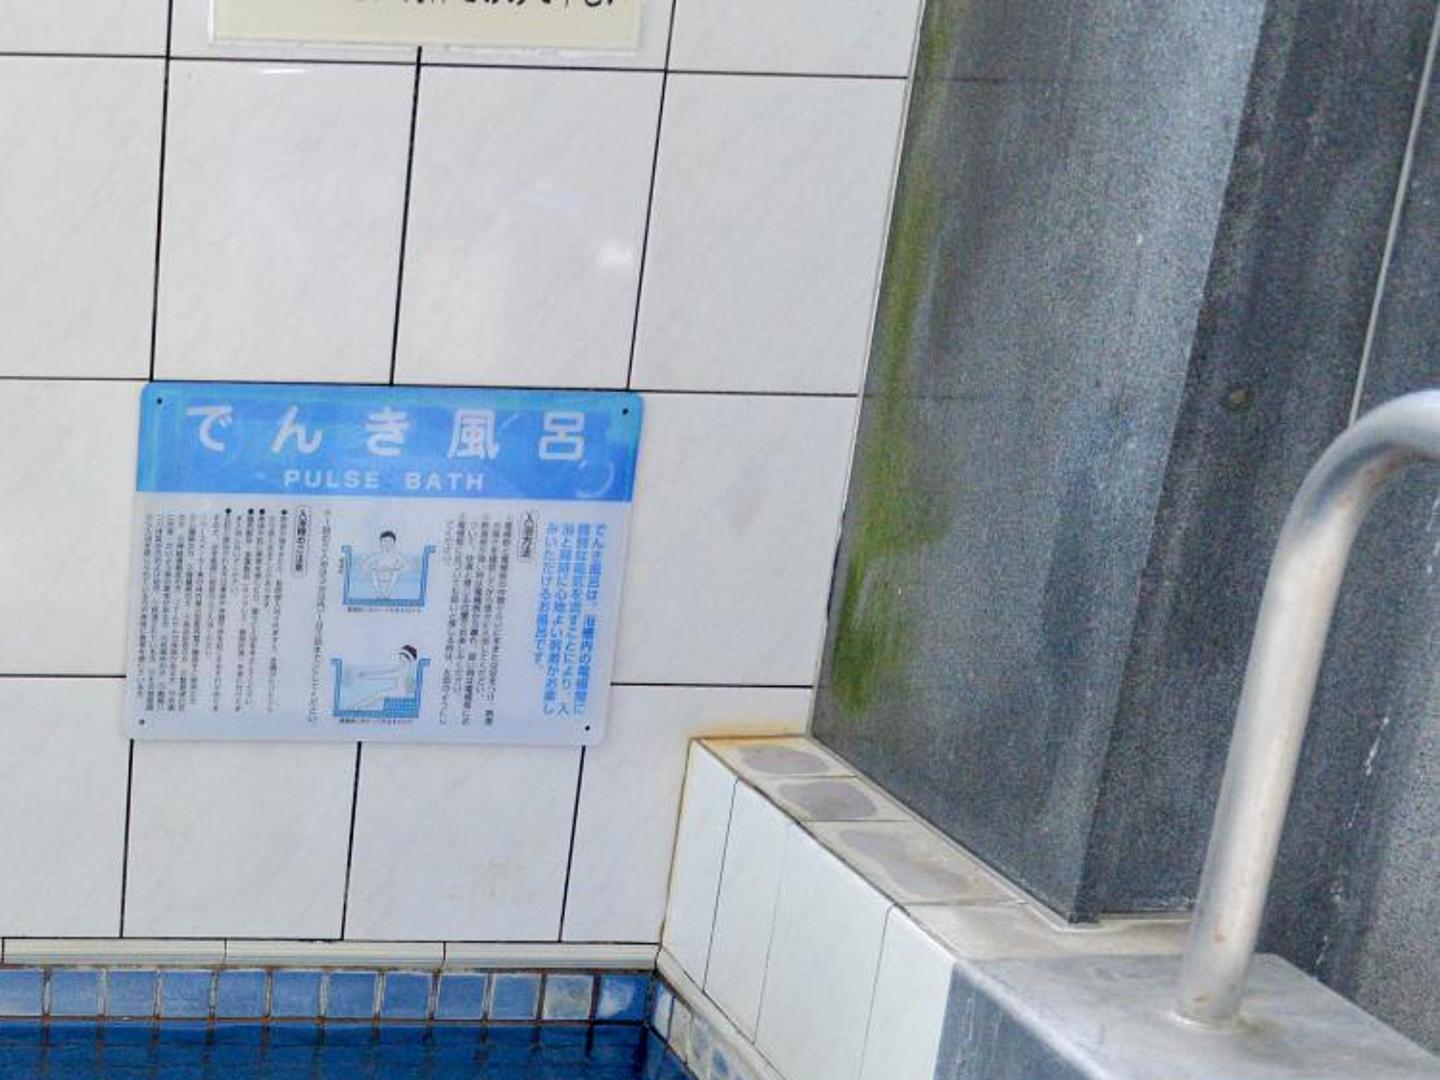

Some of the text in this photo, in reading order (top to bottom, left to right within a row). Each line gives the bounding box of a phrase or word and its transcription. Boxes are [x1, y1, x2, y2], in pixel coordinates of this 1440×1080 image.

[186, 404, 586, 461] でんき風呂
[283, 471, 486, 492] PULSE BATH
